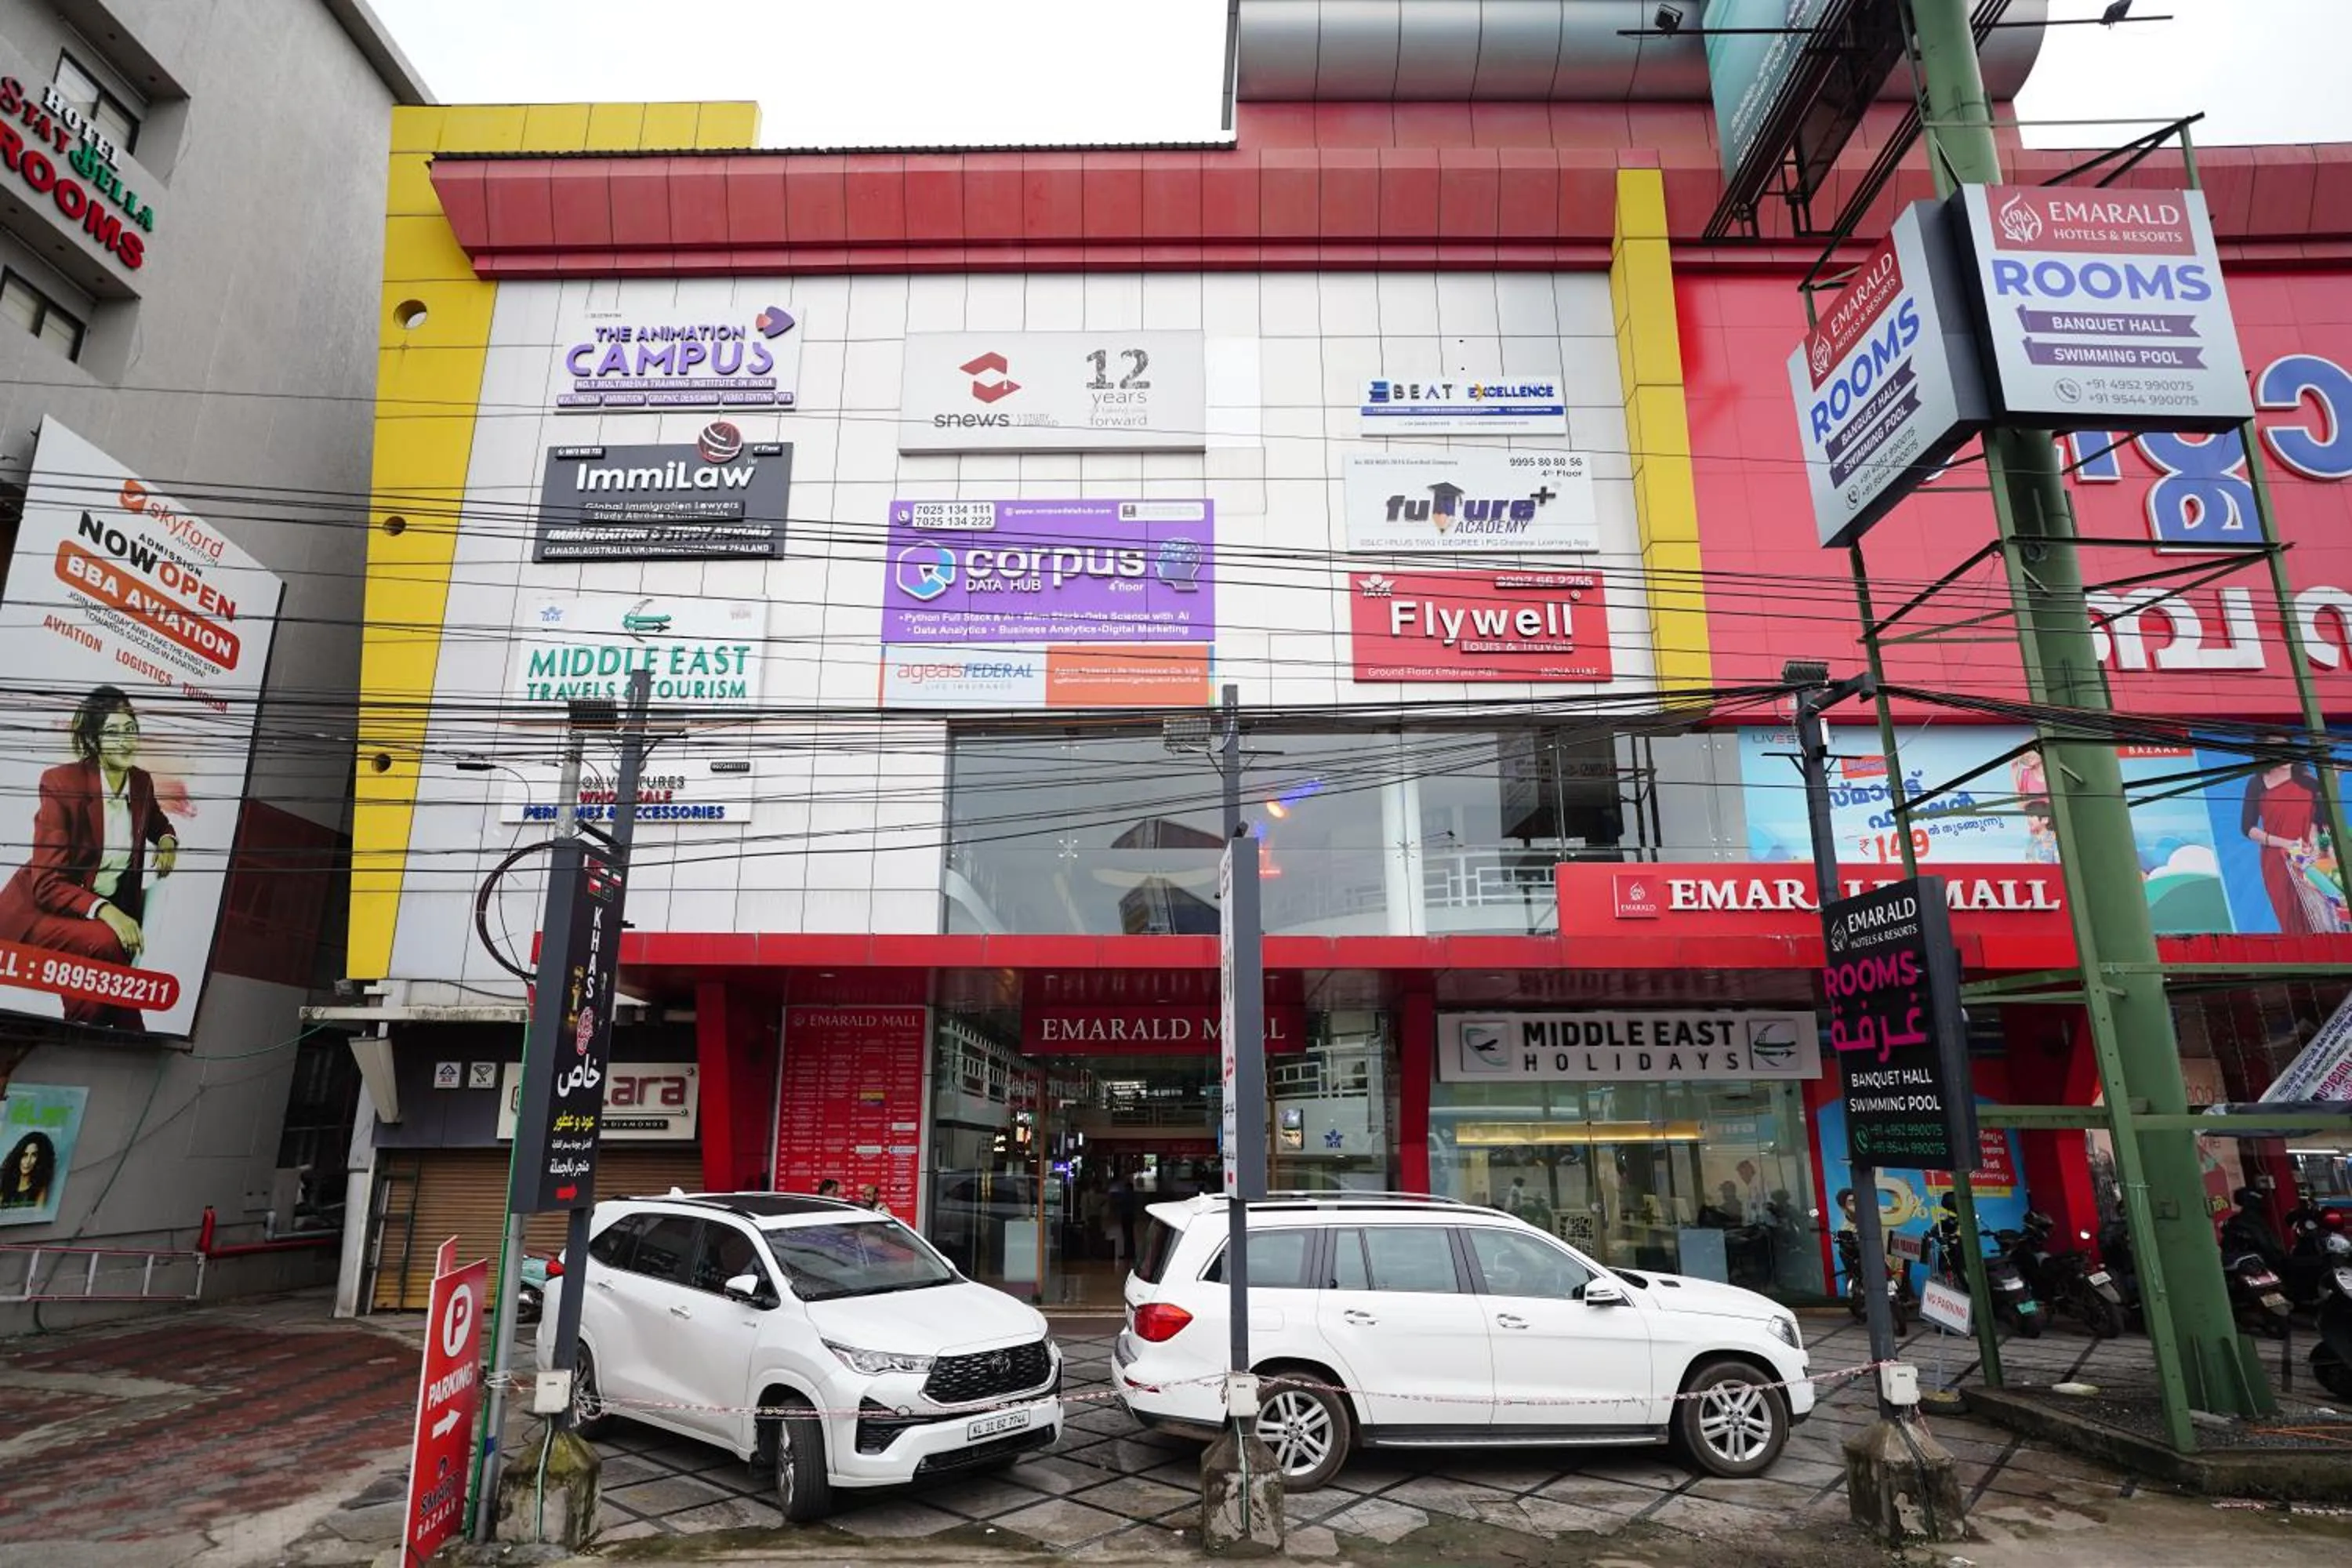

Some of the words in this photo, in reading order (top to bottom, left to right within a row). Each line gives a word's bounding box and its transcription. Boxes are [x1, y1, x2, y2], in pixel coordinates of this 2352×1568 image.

[0, 77, 71, 155] STAY
[42, 86, 121, 171] HOTEL
[0, 122, 144, 269] ROOMS
[2049, 201, 2180, 226] EMARALD
[2053, 229, 2105, 241] HOTELS
[2110, 230, 2116, 241] &
[2122, 231, 2183, 243] RESORTS
[1831, 252, 1893, 334] EMARALD
[1991, 259, 2212, 302] ROOMS
[1835, 320, 1860, 353] HOTELS
[1866, 275, 1896, 318] RESORTS
[2052, 317, 2125, 332] BANQUET
[2130, 320, 2171, 332] HALL
[596, 326, 632, 343] THE
[637, 325, 746, 343] ANIMATION
[566, 342, 774, 377] CAMPUS
[2054, 348, 2136, 363] SWIMMING
[2141, 351, 2183, 365] POOL
[1086, 349, 1151, 390] 12
[1810, 297, 1920, 444] ROOMS
[1468, 383, 1554, 401] EXCELLENCE
[2111, 379, 2142, 390] 4952
[2145, 380, 2194, 392] 990075
[1091, 392, 1147, 408] years
[2111, 394, 2146, 405] 9544
[2148, 395, 2199, 407] 990075
[934, 413, 1010, 427] snews
[1090, 415, 1147, 427] forward
[1841, 408, 1877, 445] BANQUET
[1878, 381, 1901, 411] HALL
[1843, 429, 1884, 474] SWIMMING
[1885, 404, 1908, 433] POOL
[1538, 457, 1551, 466] 80
[1553, 457, 1566, 466] 80
[1569, 457, 1582, 466] 56
[576, 461, 755, 491] ImmiLaw
[626, 502, 691, 512] Immigration
[695, 502, 739, 510] Lawyers
[916, 506, 943, 514] 7025
[949, 506, 967, 514] 134
[973, 505, 990, 514] 111
[146, 501, 224, 559] skyford
[916, 517, 943, 526] 7025
[949, 517, 967, 526] 134
[971, 517, 992, 526] 222
[1455, 521, 1530, 534] ACADEMY
[78, 510, 157, 575] NOW
[159, 561, 237, 623] OPEN
[138, 532, 203, 578] ADMISSION
[965, 547, 1146, 588] corpus
[966, 580, 1003, 591] DATA
[1010, 579, 1041, 591] HUB
[67, 554, 118, 597] BBA
[125, 589, 232, 659] AVIATION
[904, 613, 939, 623] Python
[943, 613, 960, 622] Full
[964, 613, 991, 622] Stack
[43, 615, 103, 652] AVIATION
[913, 626, 937, 634] Data
[940, 626, 987, 637] Analytics
[999, 625, 1046, 634] Business
[1050, 625, 1098, 636] Analytics
[1102, 625, 1134, 635] Digital
[1138, 625, 1189, 635] Marketing
[1391, 601, 1573, 644] Flywell
[115, 648, 173, 687] LOGISTICS
[528, 646, 659, 677] MIDDLE
[669, 646, 750, 676] EAST
[1368, 667, 1404, 677] Ground
[527, 681, 616, 701] TRAVELS
[650, 681, 746, 699] OURISM
[579, 790, 673, 804] WHOSALE
[634, 805, 725, 820] CCESSORIES
[1848, 897, 1917, 932] EMARALD
[1850, 935, 1877, 950] HOTELS
[1883, 924, 1917, 942] RESORTS
[586, 906, 603, 999] KHAS
[42, 960, 170, 1004] 9895332211
[1824, 950, 1918, 998] ROOMS
[810, 1014, 877, 1028] EMARALD
[882, 1014, 917, 1028] MALL
[1042, 1018, 1190, 1040] EMARALD
[1203, 1018, 1286, 1040] ML
[1523, 1021, 1645, 1047] MIDDLE
[1655, 1020, 1734, 1047] EAST
[1524, 1052, 1740, 1073] HOLIDAYS
[557, 1054, 601, 1098] خاص
[1851, 1069, 1900, 1089] BANQUET
[1903, 1067, 1933, 1085] HALL
[1849, 1097, 1906, 1113] SWIMMING
[1909, 1095, 1941, 1111] POOL
[427, 1362, 473, 1410] PARKING
[416, 1497, 457, 1542] BAZAAR
